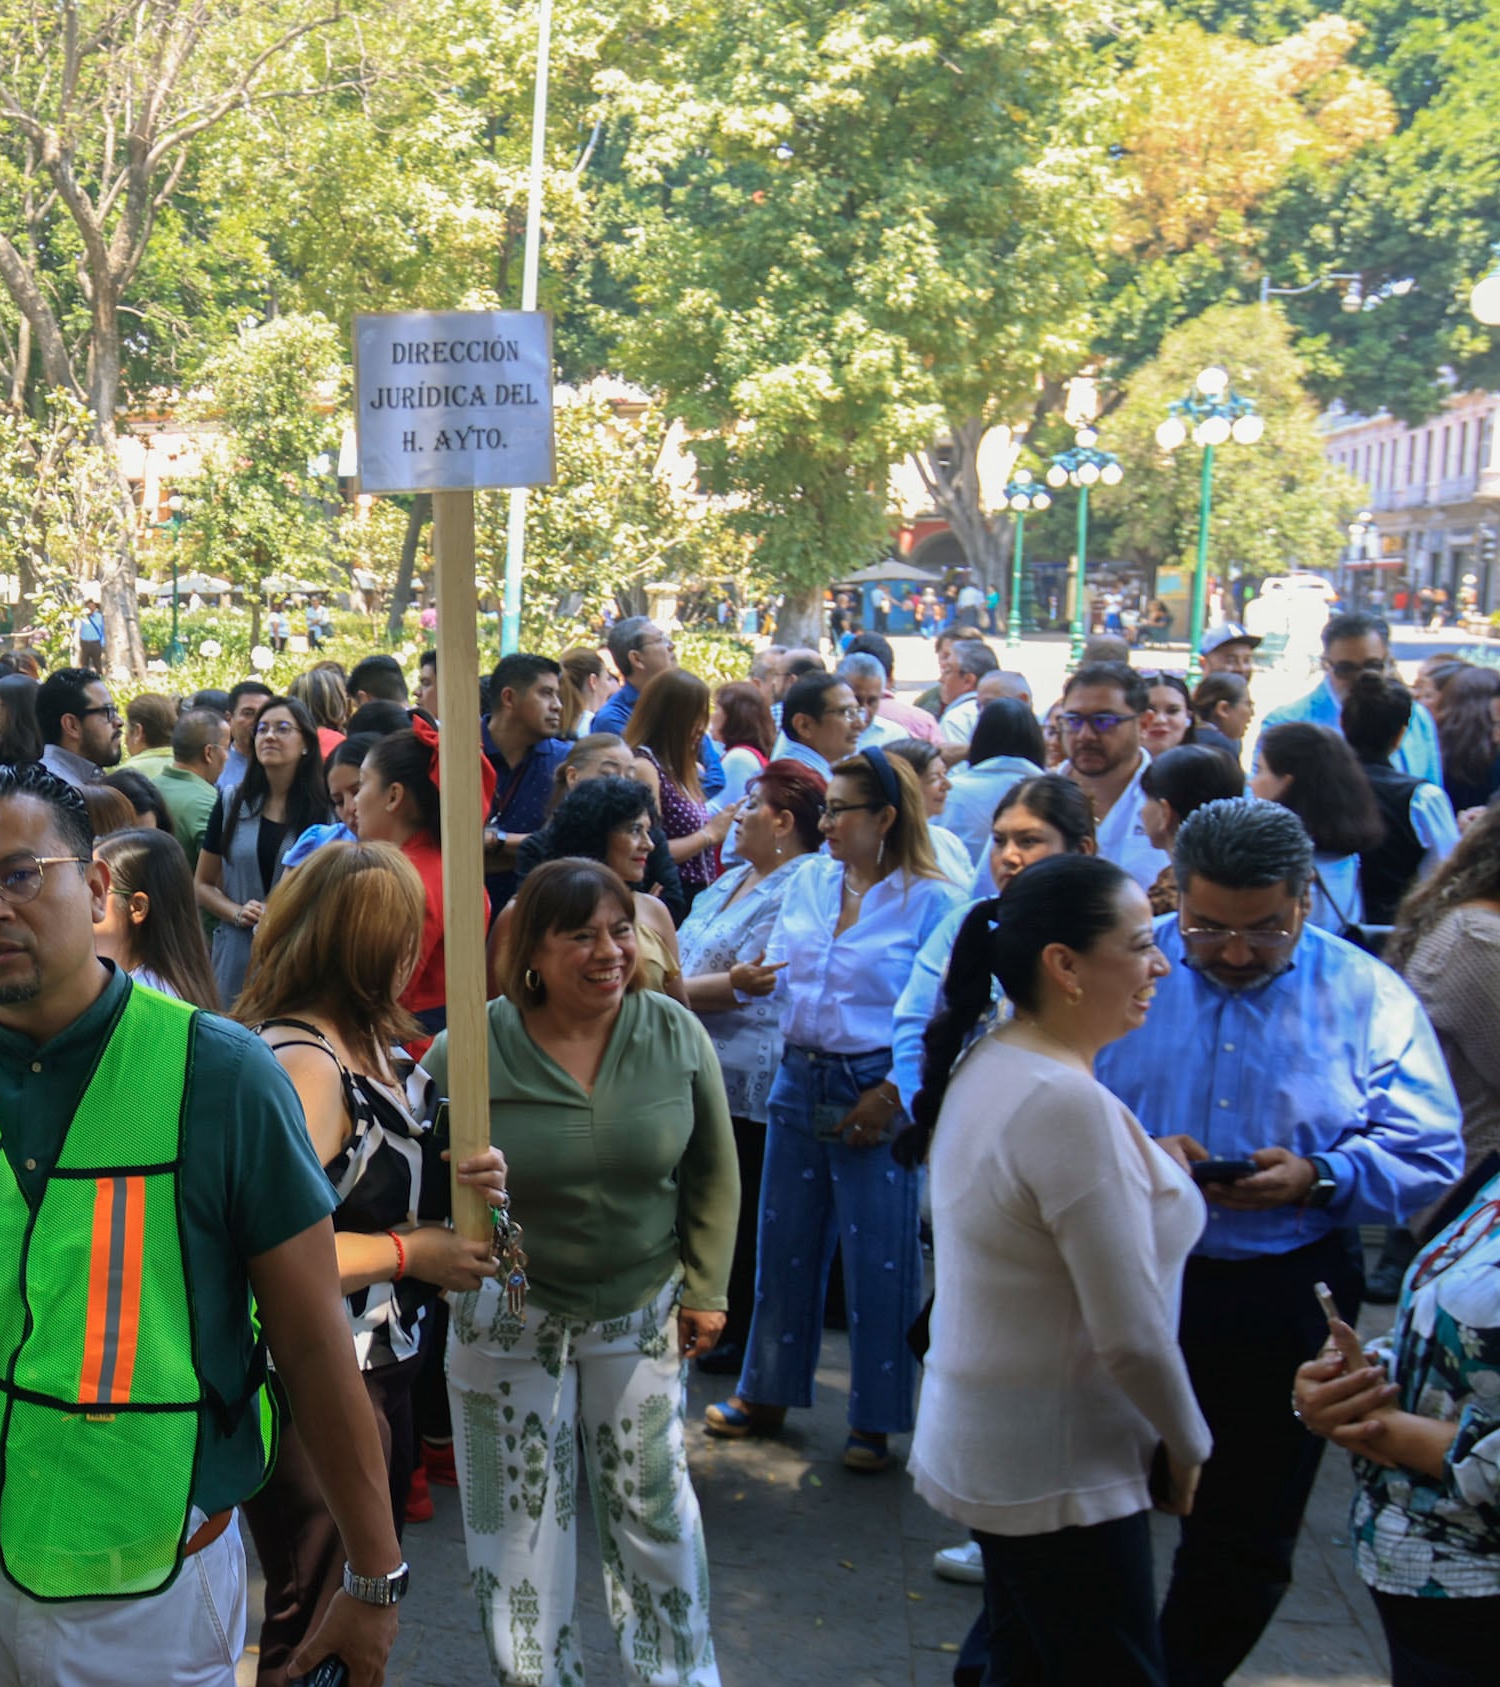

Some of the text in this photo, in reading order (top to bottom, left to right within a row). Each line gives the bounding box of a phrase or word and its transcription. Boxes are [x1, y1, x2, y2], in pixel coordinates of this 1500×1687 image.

[392, 335, 519, 365] DIRECCIÓN
[370, 381, 539, 409] JURÍDICA DEL
[402, 425, 508, 452] H. AYTO.
